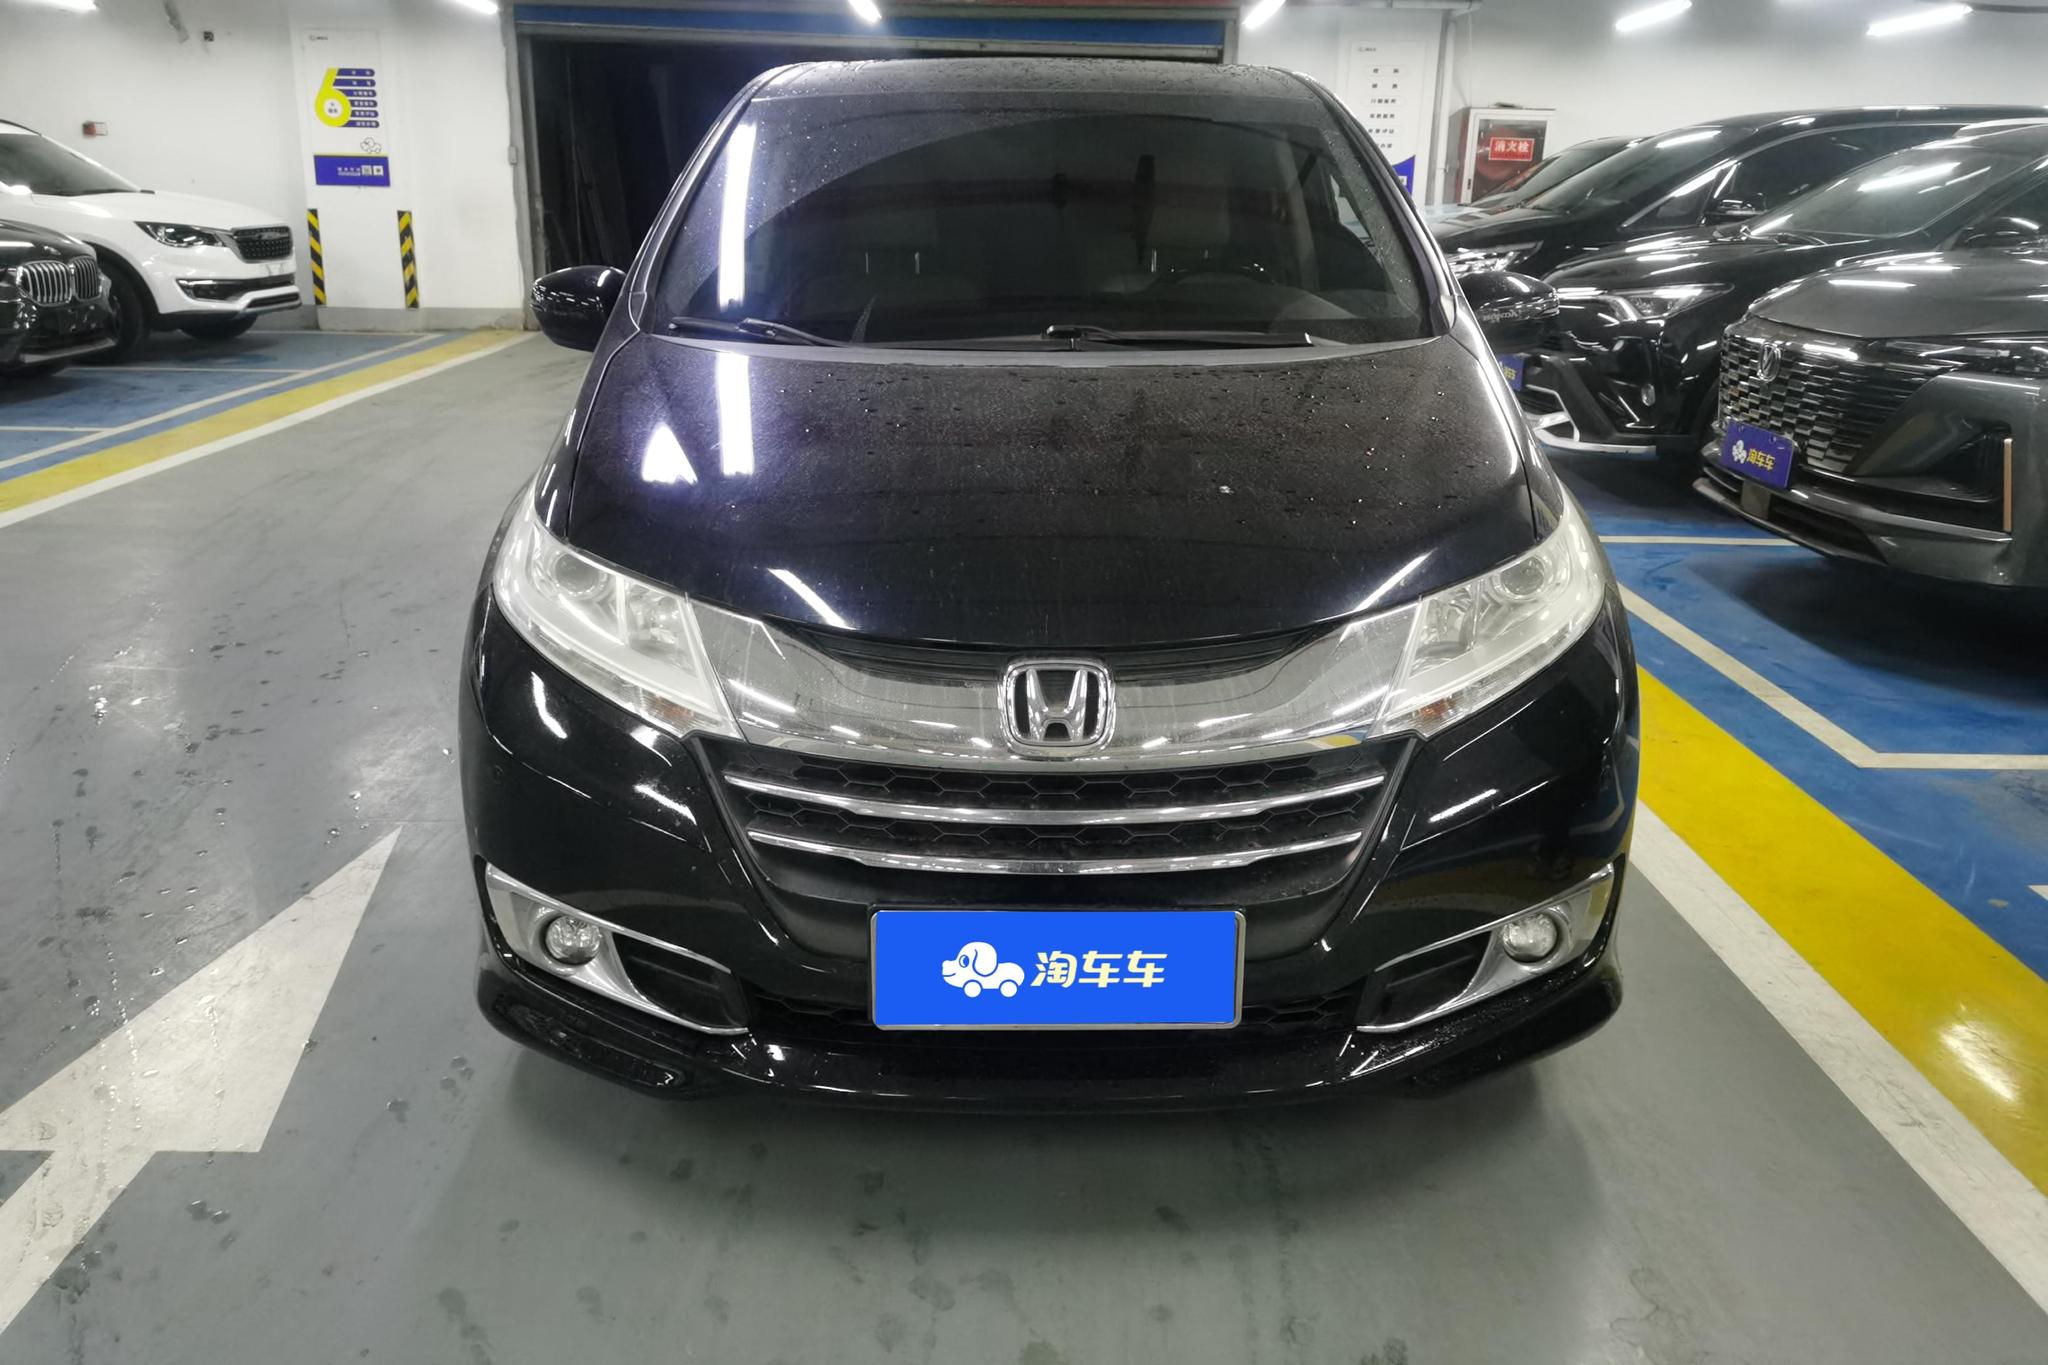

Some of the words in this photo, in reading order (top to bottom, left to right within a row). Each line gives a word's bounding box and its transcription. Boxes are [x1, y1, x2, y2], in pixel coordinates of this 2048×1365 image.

[1495, 140, 1529, 152] 消火栓
[1747, 448, 1775, 471] 淘车车
